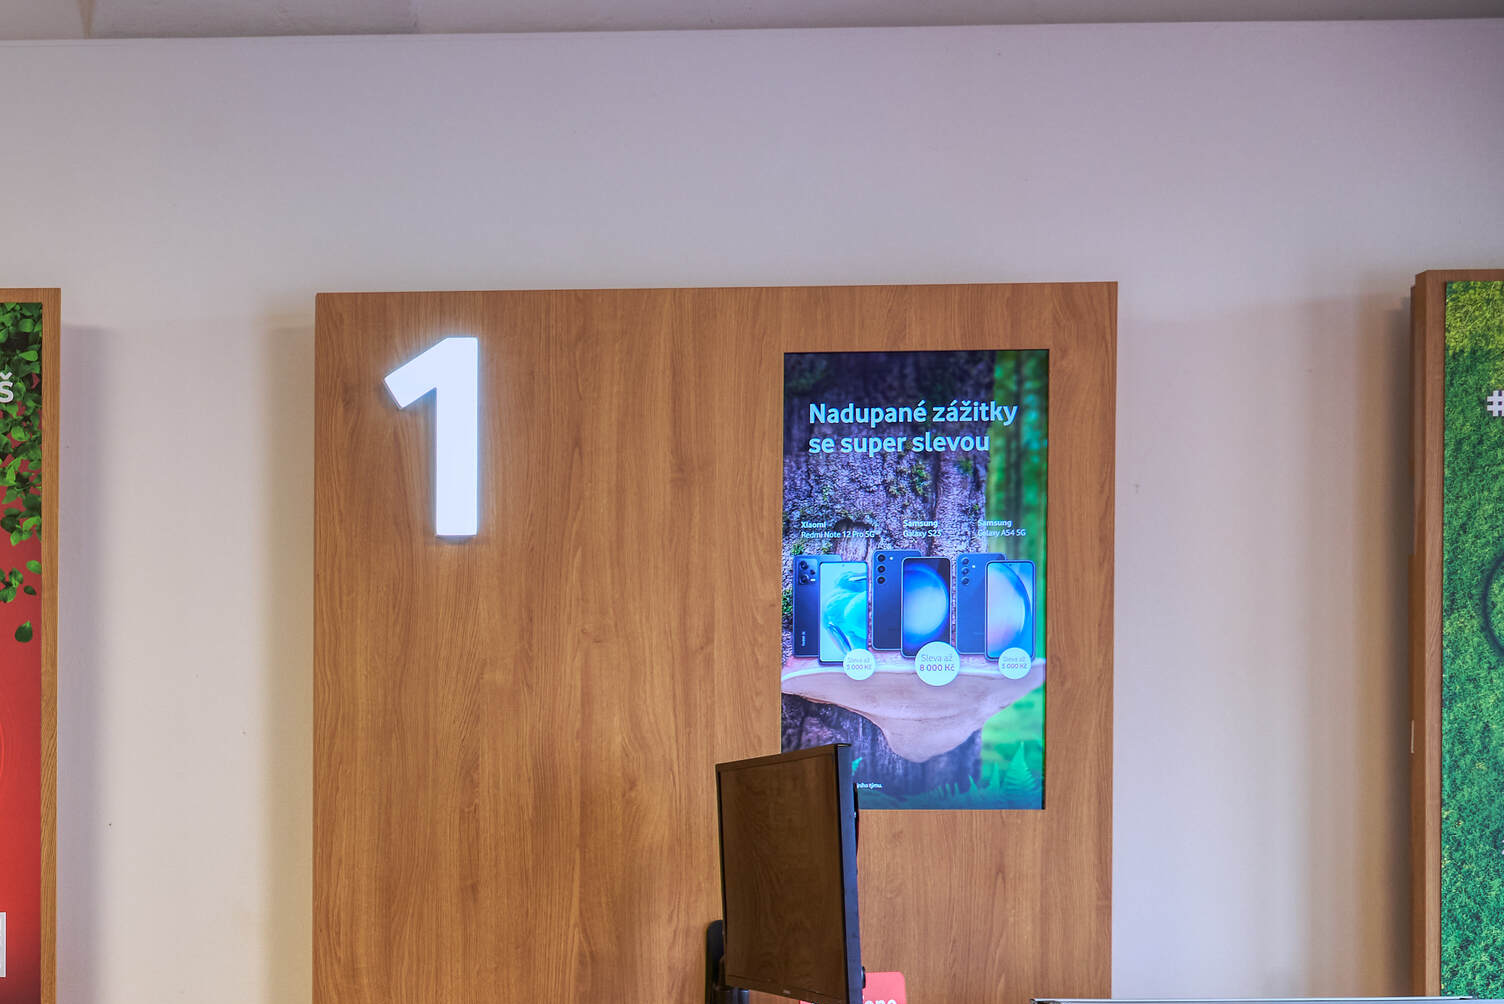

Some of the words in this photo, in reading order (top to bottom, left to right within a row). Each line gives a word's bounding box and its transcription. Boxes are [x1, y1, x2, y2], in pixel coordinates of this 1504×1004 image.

[809, 400, 927, 428] Nadupané
[932, 399, 1018, 425] zážitky
[383, 337, 478, 537] 1
[808, 437, 835, 453] se
[840, 436, 907, 457] super
[911, 432, 990, 452] slevou
[801, 521, 827, 529] Xiaomi
[903, 520, 938, 528] Samsung
[978, 519, 1013, 528] Samsung
[842, 530, 851, 538] 12
[903, 530, 927, 539] Galaxy
[921, 654, 943, 662] Sleva
[926, 664, 943, 672] 000
